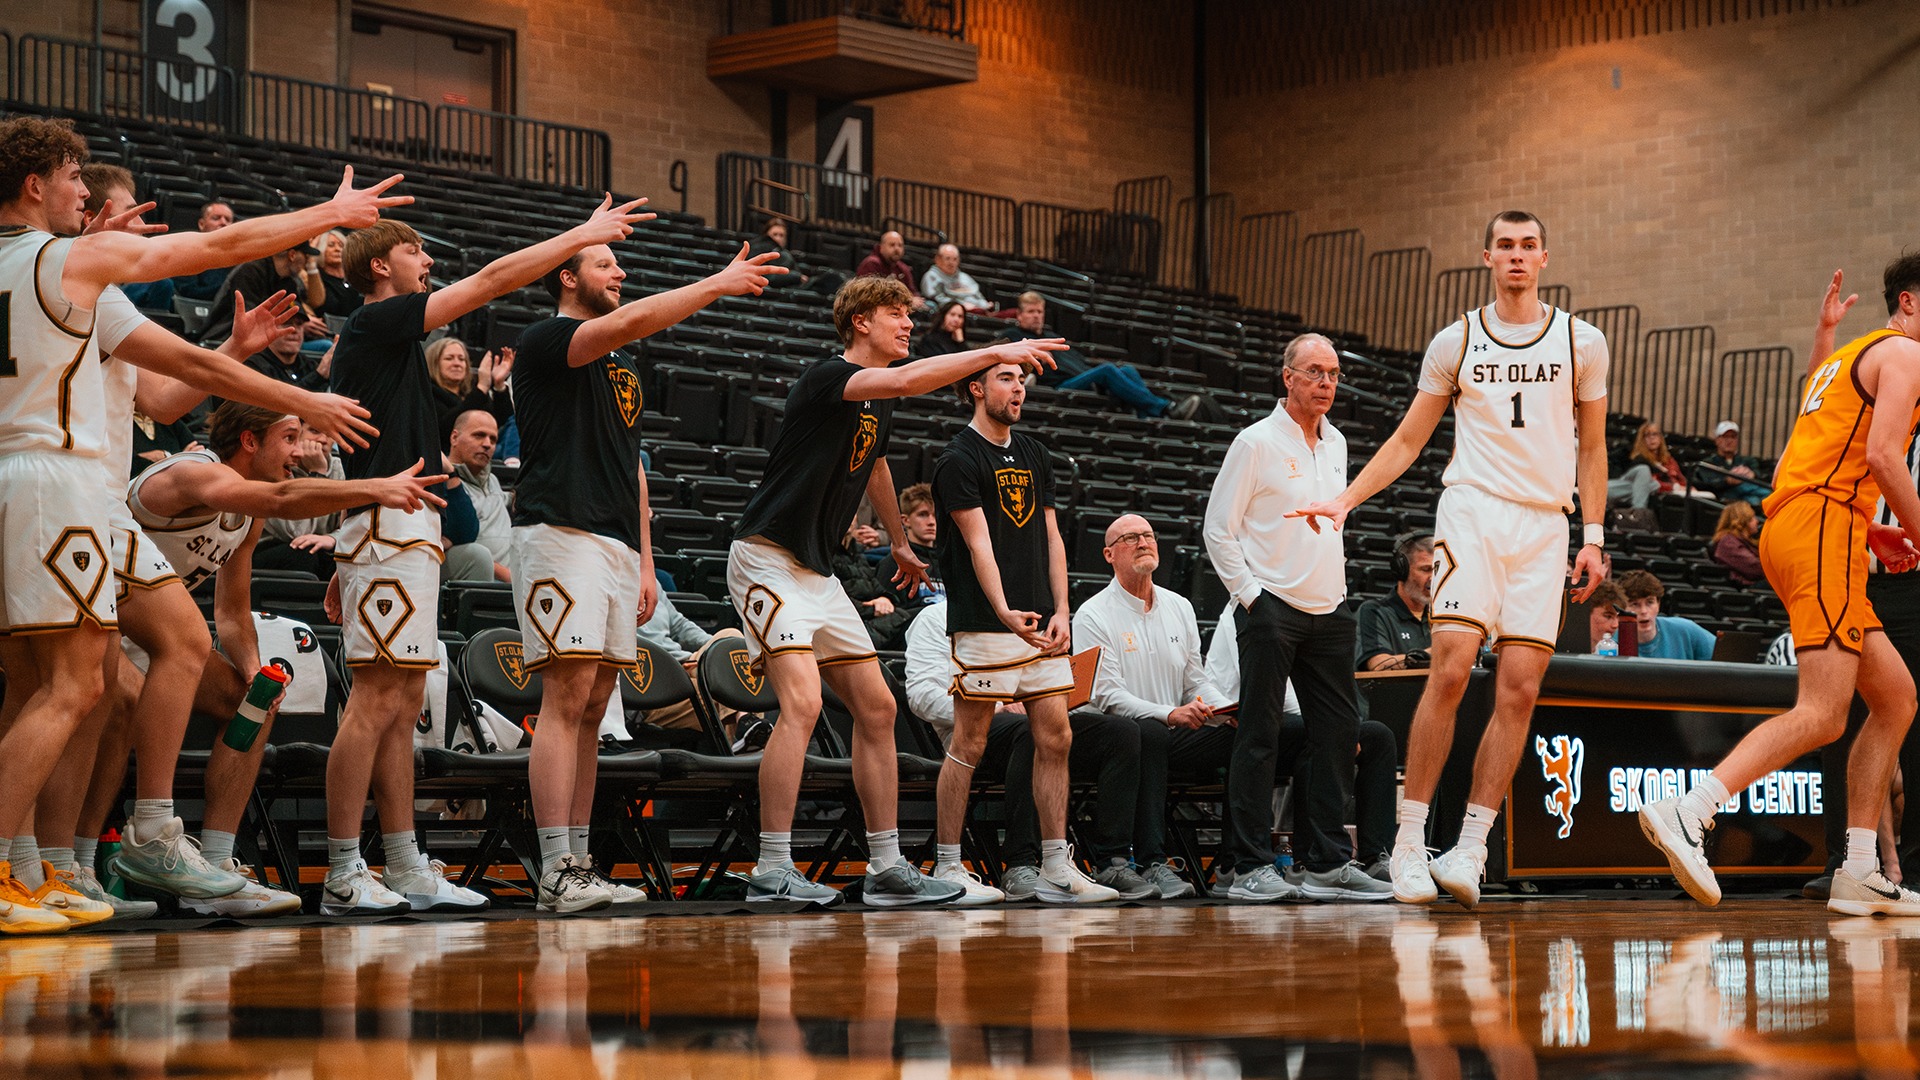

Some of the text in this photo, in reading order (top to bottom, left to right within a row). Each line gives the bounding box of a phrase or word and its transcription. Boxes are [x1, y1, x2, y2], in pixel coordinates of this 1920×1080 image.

[155, 0, 217, 103] 3
[822, 116, 869, 209] 4
[1473, 363, 1561, 383] ST. OLAF
[1801, 359, 1842, 417] 12
[1511, 391, 1525, 428] 1
